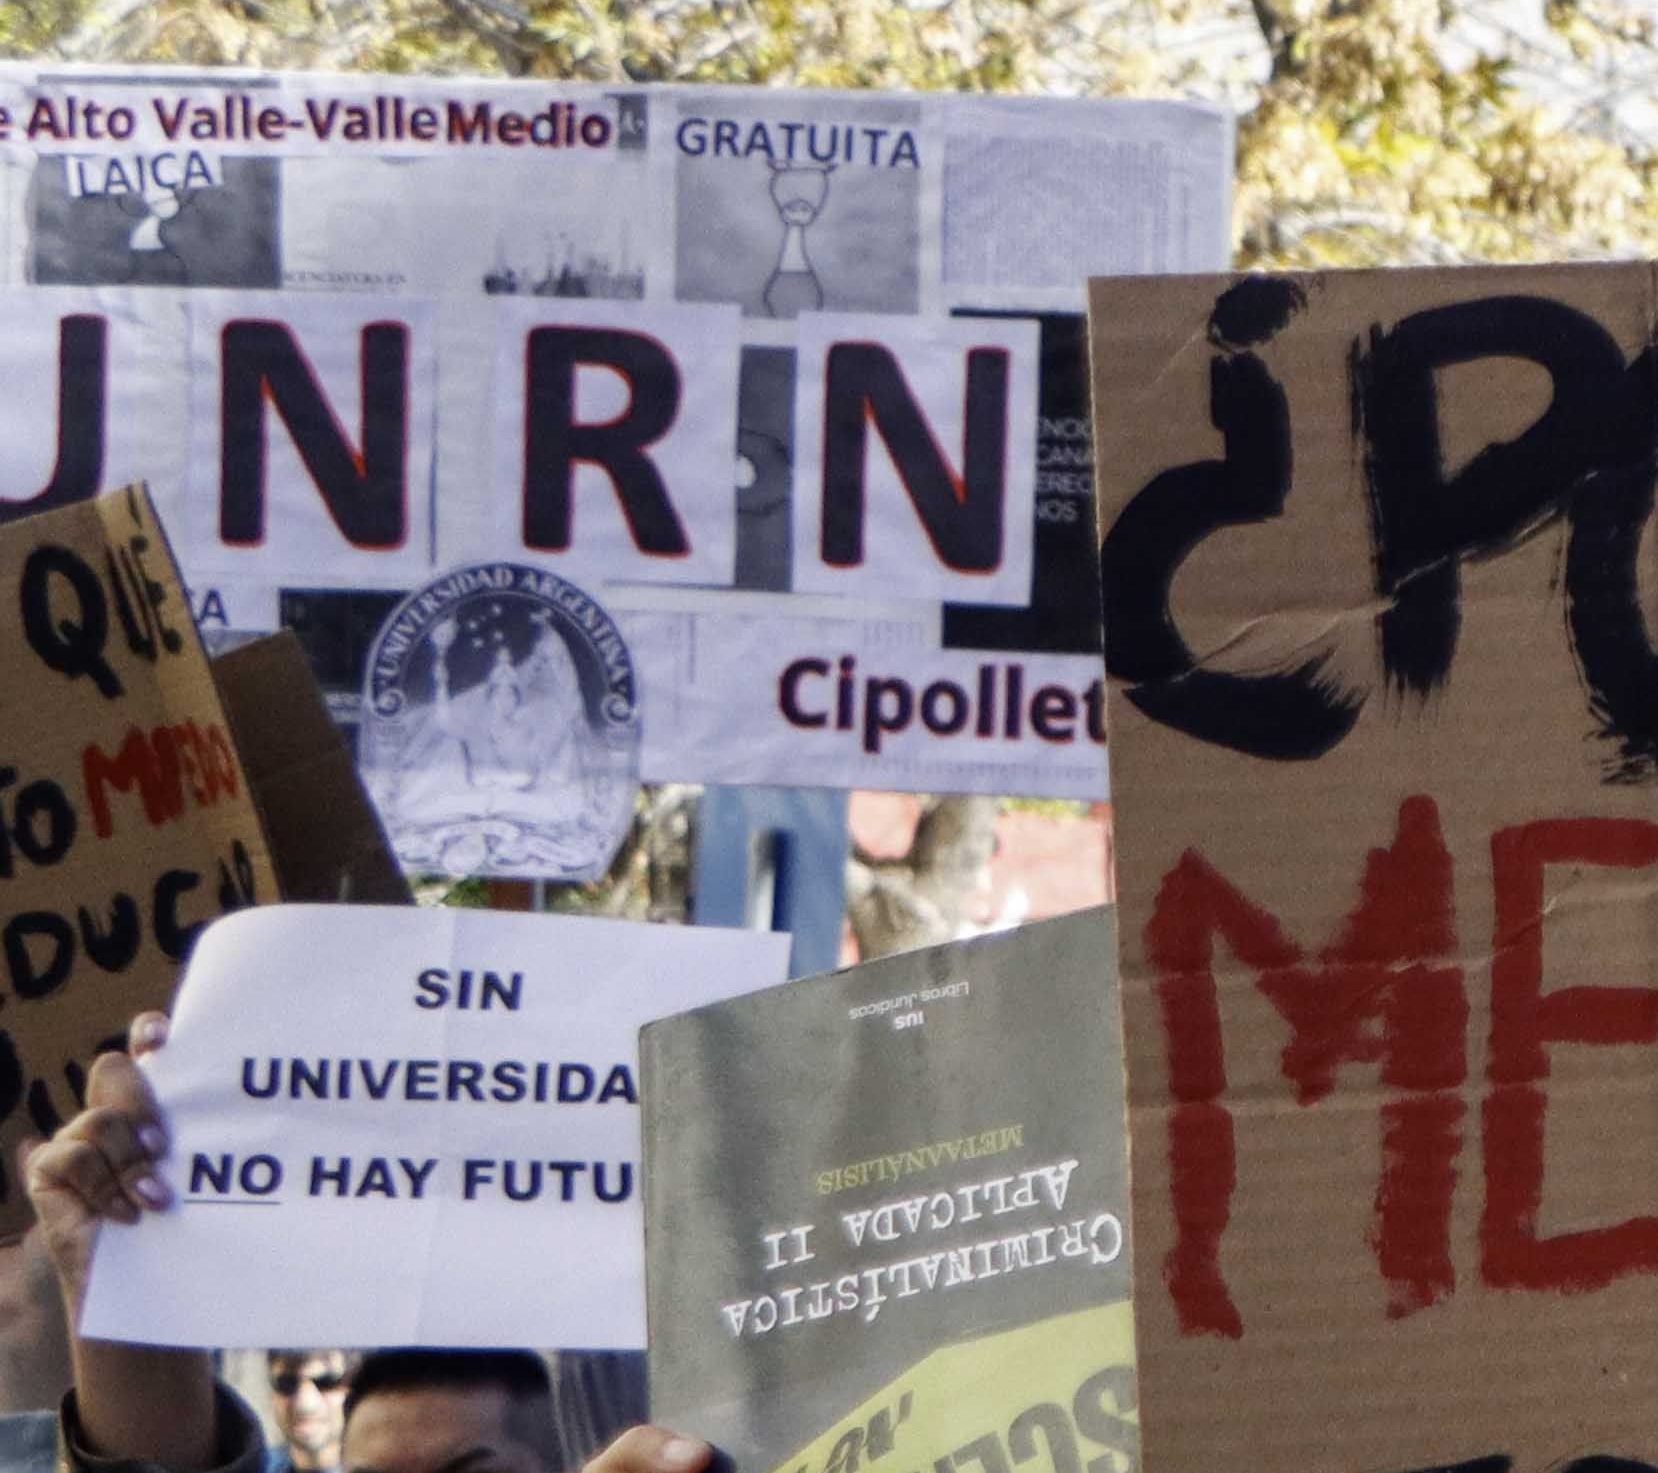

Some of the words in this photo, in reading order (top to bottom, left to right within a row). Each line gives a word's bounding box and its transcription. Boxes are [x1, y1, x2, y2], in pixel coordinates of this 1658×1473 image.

[25, 95, 135, 141] Alto
[153, 95, 438, 143] Valle-Valle
[445, 100, 612, 149] Medio
[675, 115, 921, 170] GRATUITA
[777, 652, 1107, 754] Cipollet
[414, 967, 524, 1011] SIN
[921, 980, 970, 1000] Libros
[241, 1056, 639, 1105] UNIVERSIDA
[188, 1152, 284, 1196] NO
[308, 1156, 439, 1199] HAY
[461, 1158, 633, 1203] FUTU
[762, 1224, 815, 1271] II
